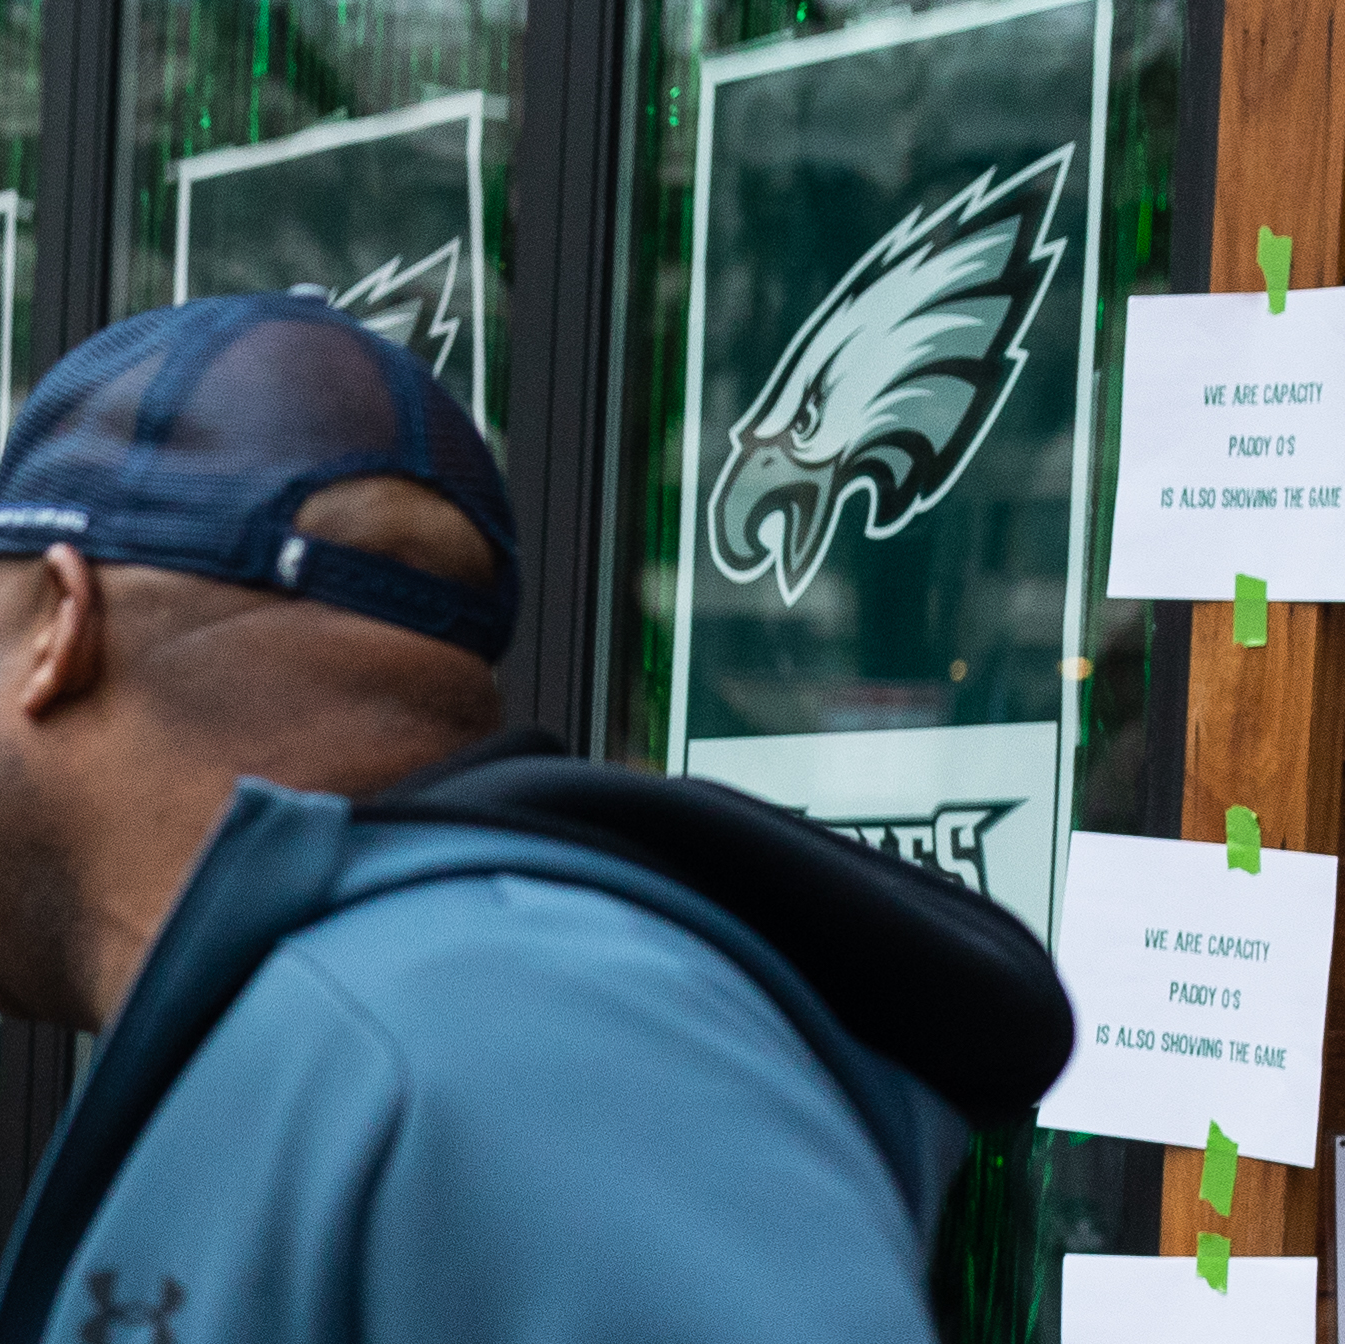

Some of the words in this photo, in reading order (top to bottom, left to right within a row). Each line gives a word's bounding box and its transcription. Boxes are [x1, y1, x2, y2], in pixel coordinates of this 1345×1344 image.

[1203, 384, 1227, 407] WE
[1231, 383, 1259, 406] ARE
[1262, 381, 1324, 406] CAPACITY
[1227, 434, 1272, 458] PADDY
[1160, 486, 1175, 509] IS
[1178, 486, 1217, 510] ALSO
[1220, 487, 1278, 510] SHOWING
[1283, 486, 1305, 509] THE
[1307, 485, 1343, 509] GAME
[1144, 927, 1169, 951] WE
[1173, 930, 1204, 955] ARE
[1207, 934, 1271, 962] CAPACITY
[1168, 980, 1218, 1007] PADDY
[1095, 1023, 1111, 1046] IS
[1114, 1025, 1156, 1052] ALSO
[1160, 1031, 1224, 1060] SHOWING
[1228, 1040, 1251, 1065] THE
[1253, 1044, 1288, 1071] GAME
